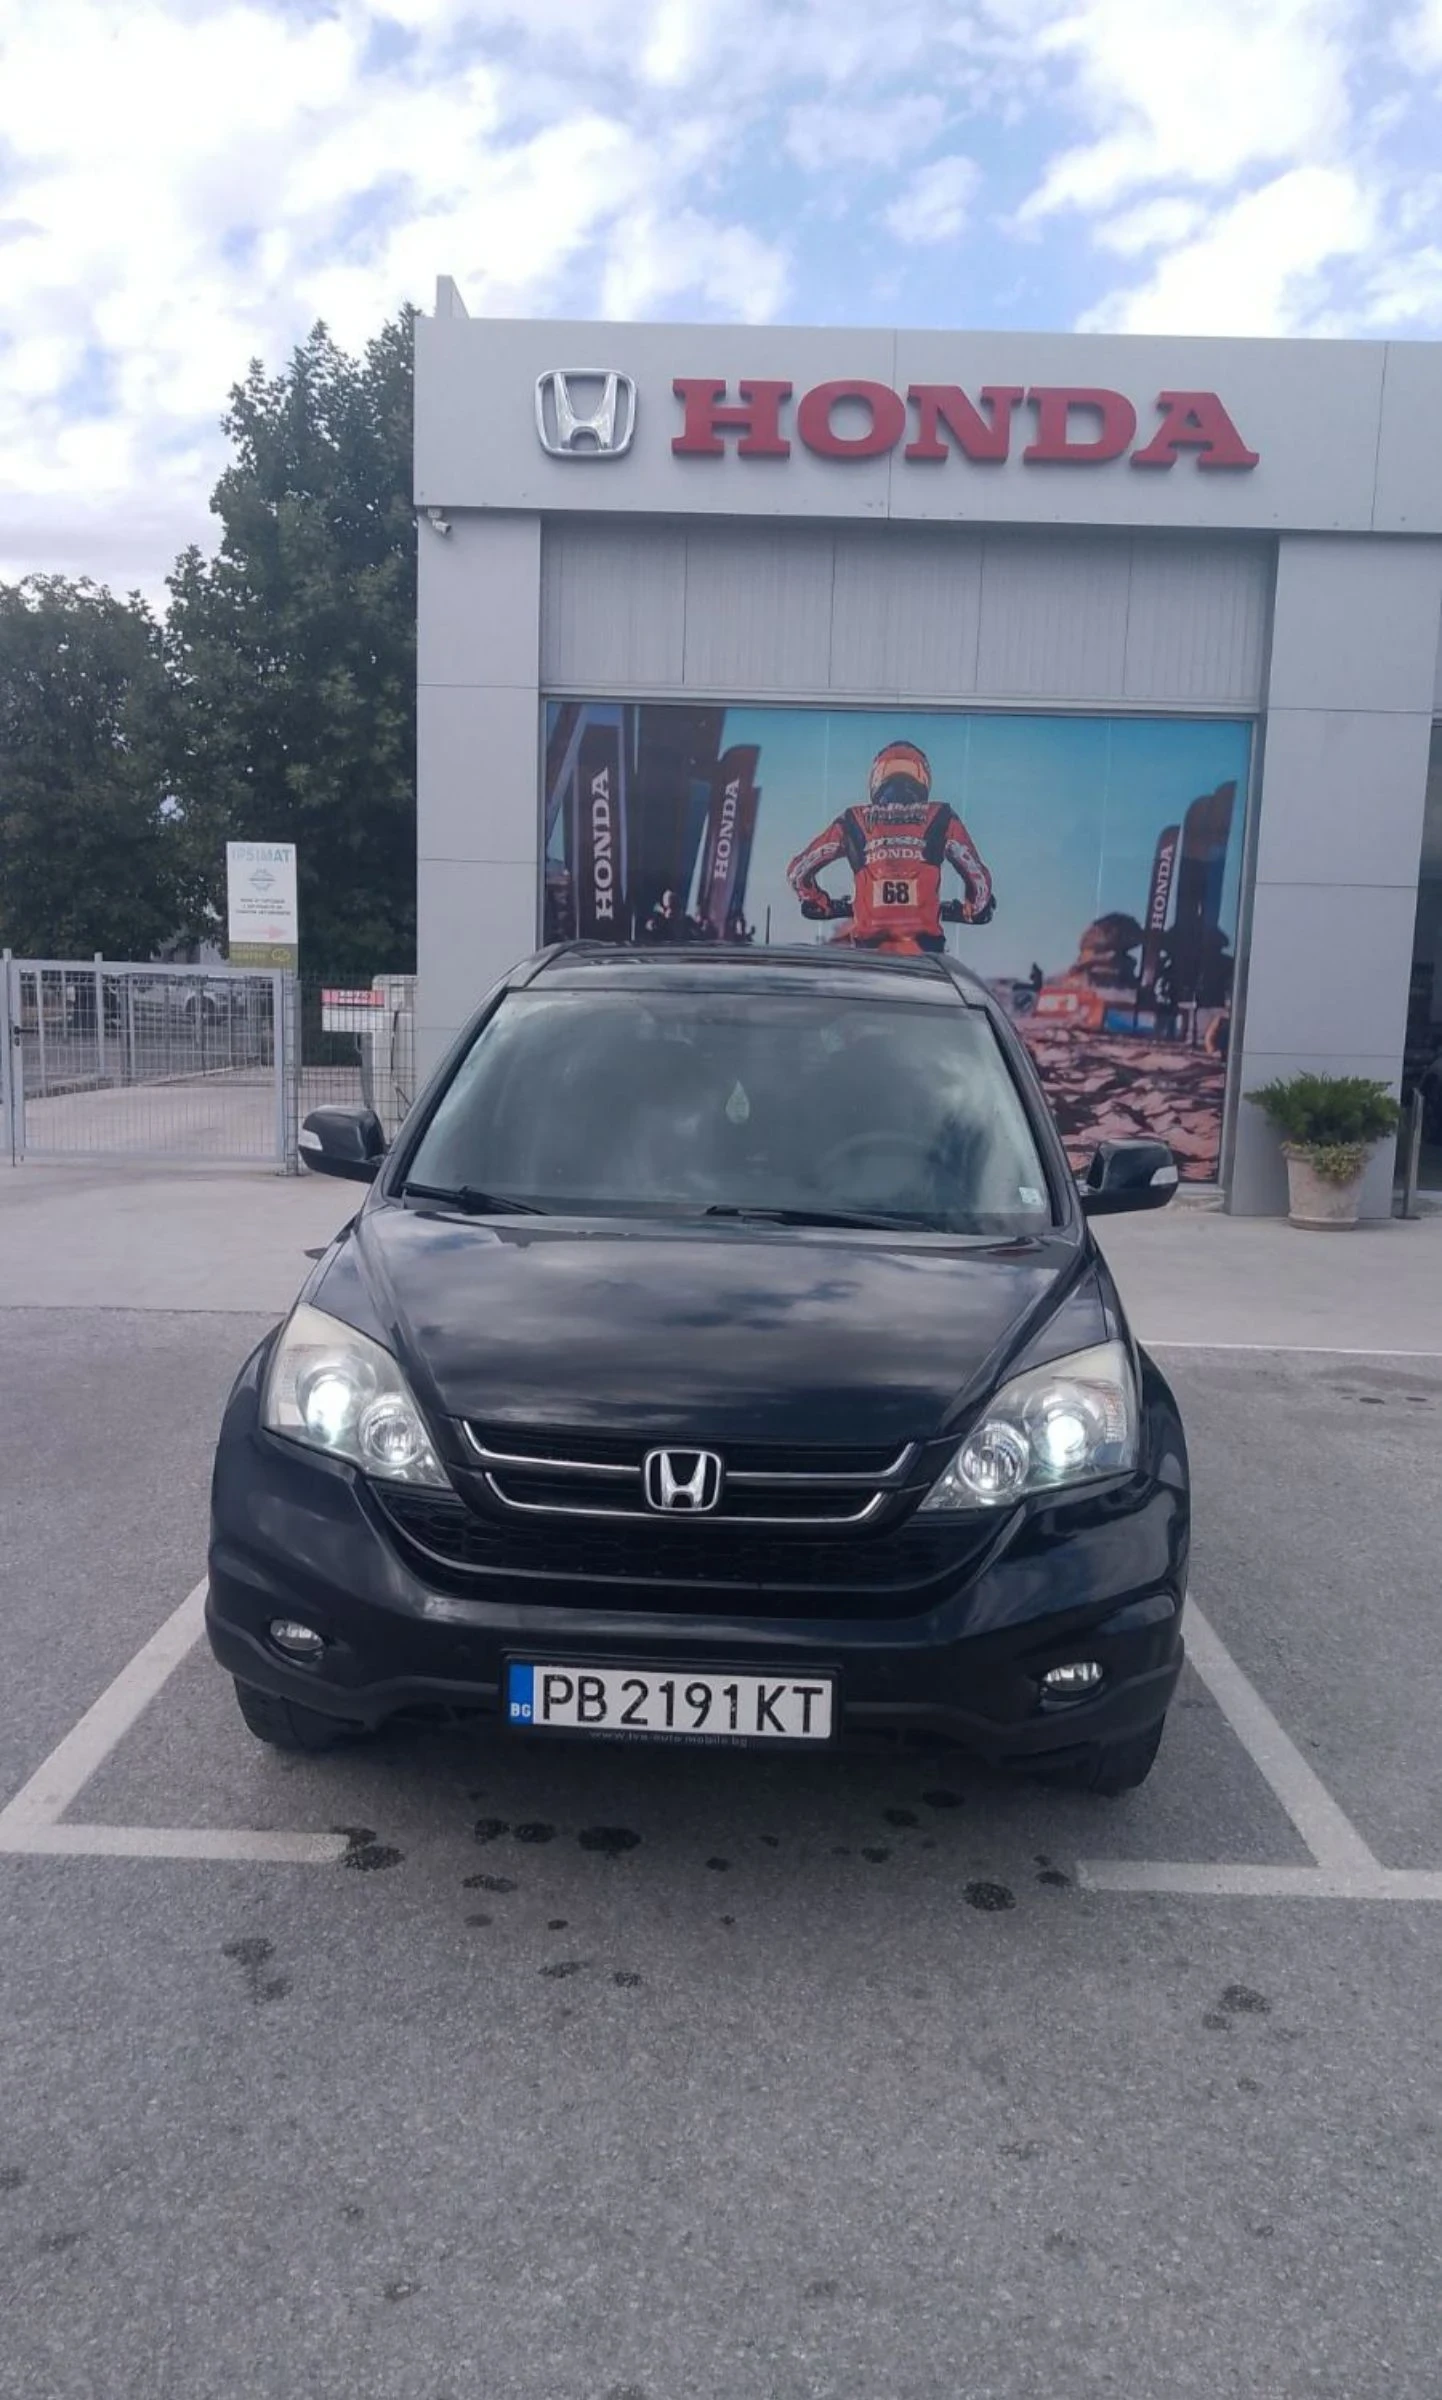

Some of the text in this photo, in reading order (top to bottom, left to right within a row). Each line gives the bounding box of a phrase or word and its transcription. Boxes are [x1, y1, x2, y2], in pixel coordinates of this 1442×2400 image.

[672, 378, 1260, 470] HONDA
[592, 766, 615, 920] HONDA
[714, 778, 741, 880] HONDA
[866, 848, 926, 865] HONDA
[882, 880, 910, 905] 68
[1151, 844, 1174, 930] HONDA
[510, 1702, 532, 1717] BG
[542, 1673, 824, 1733] PB 2191 KT
